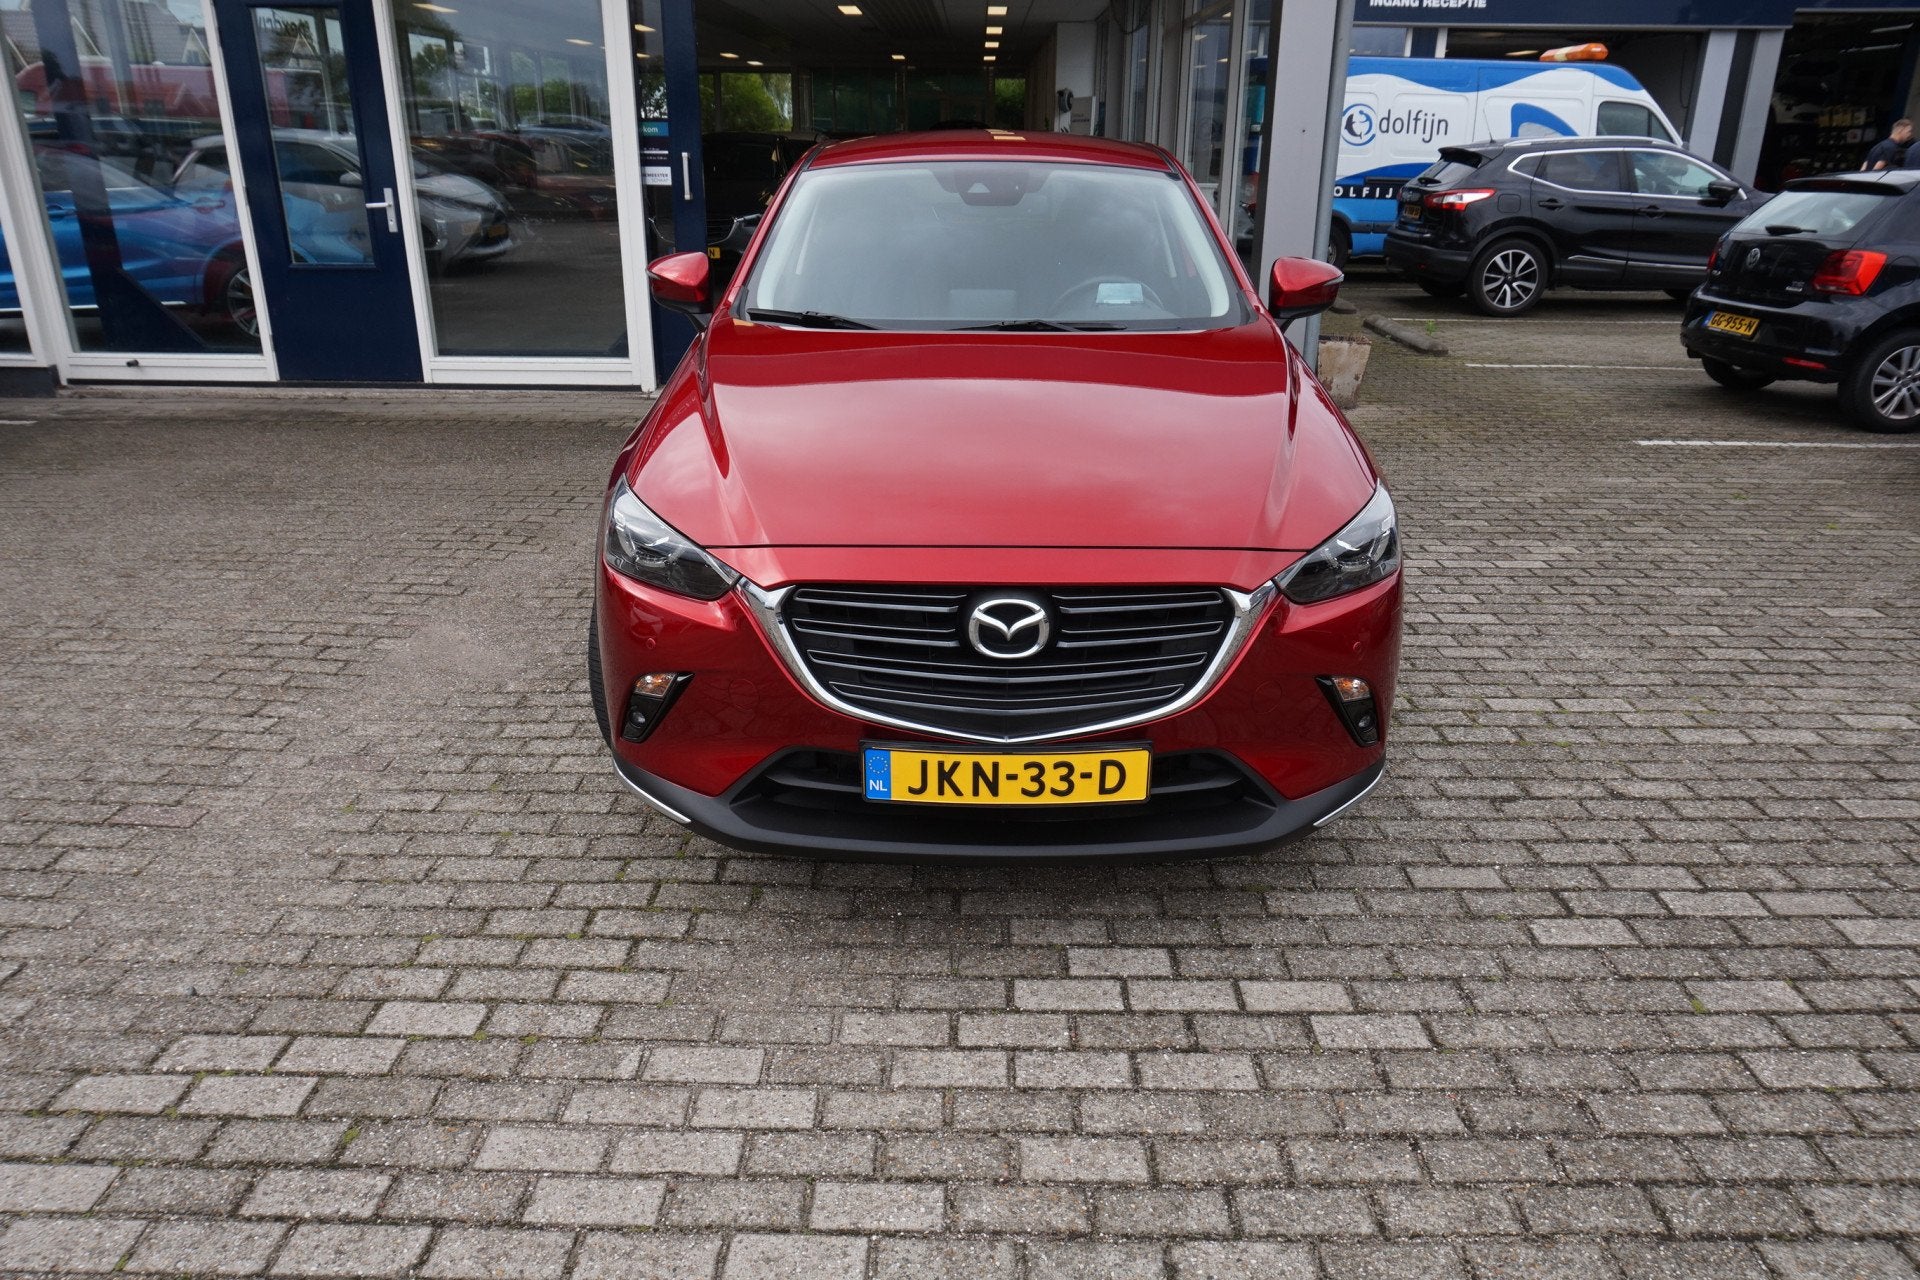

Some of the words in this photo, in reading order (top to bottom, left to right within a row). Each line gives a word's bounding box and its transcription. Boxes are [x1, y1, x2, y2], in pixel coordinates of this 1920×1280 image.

[1423, 0, 1487, 9] RECEPTIE
[1379, 109, 1449, 144] dolfijn
[1710, 313, 1756, 334] GG-955-N
[869, 779, 888, 792] NL
[908, 759, 1127, 798] JKN-33-D
